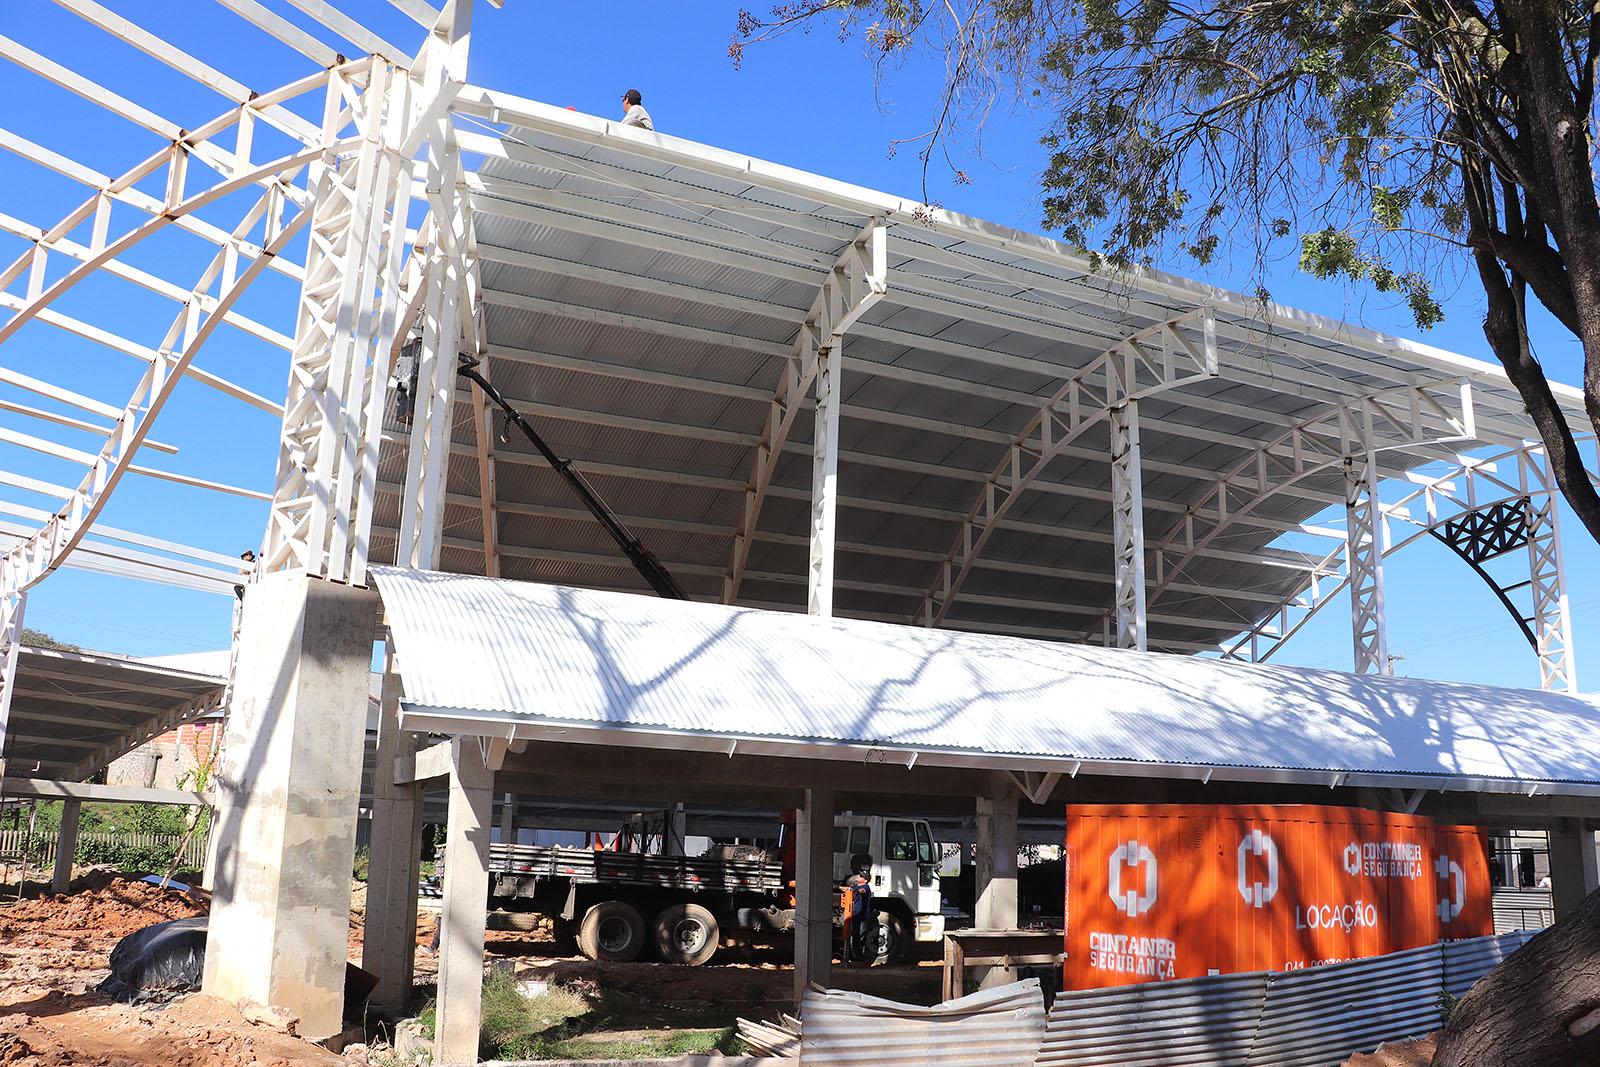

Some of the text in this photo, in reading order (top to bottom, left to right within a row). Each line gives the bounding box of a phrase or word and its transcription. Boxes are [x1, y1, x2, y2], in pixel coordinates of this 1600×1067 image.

[1363, 843, 1422, 861] CONTAINER
[1363, 860, 1422, 880] SEGURANÇA
[1296, 899, 1377, 933] LOCAÇÃO
[1089, 931, 1176, 960] CONTAINER
[1089, 951, 1176, 981] SEGURANÇA
